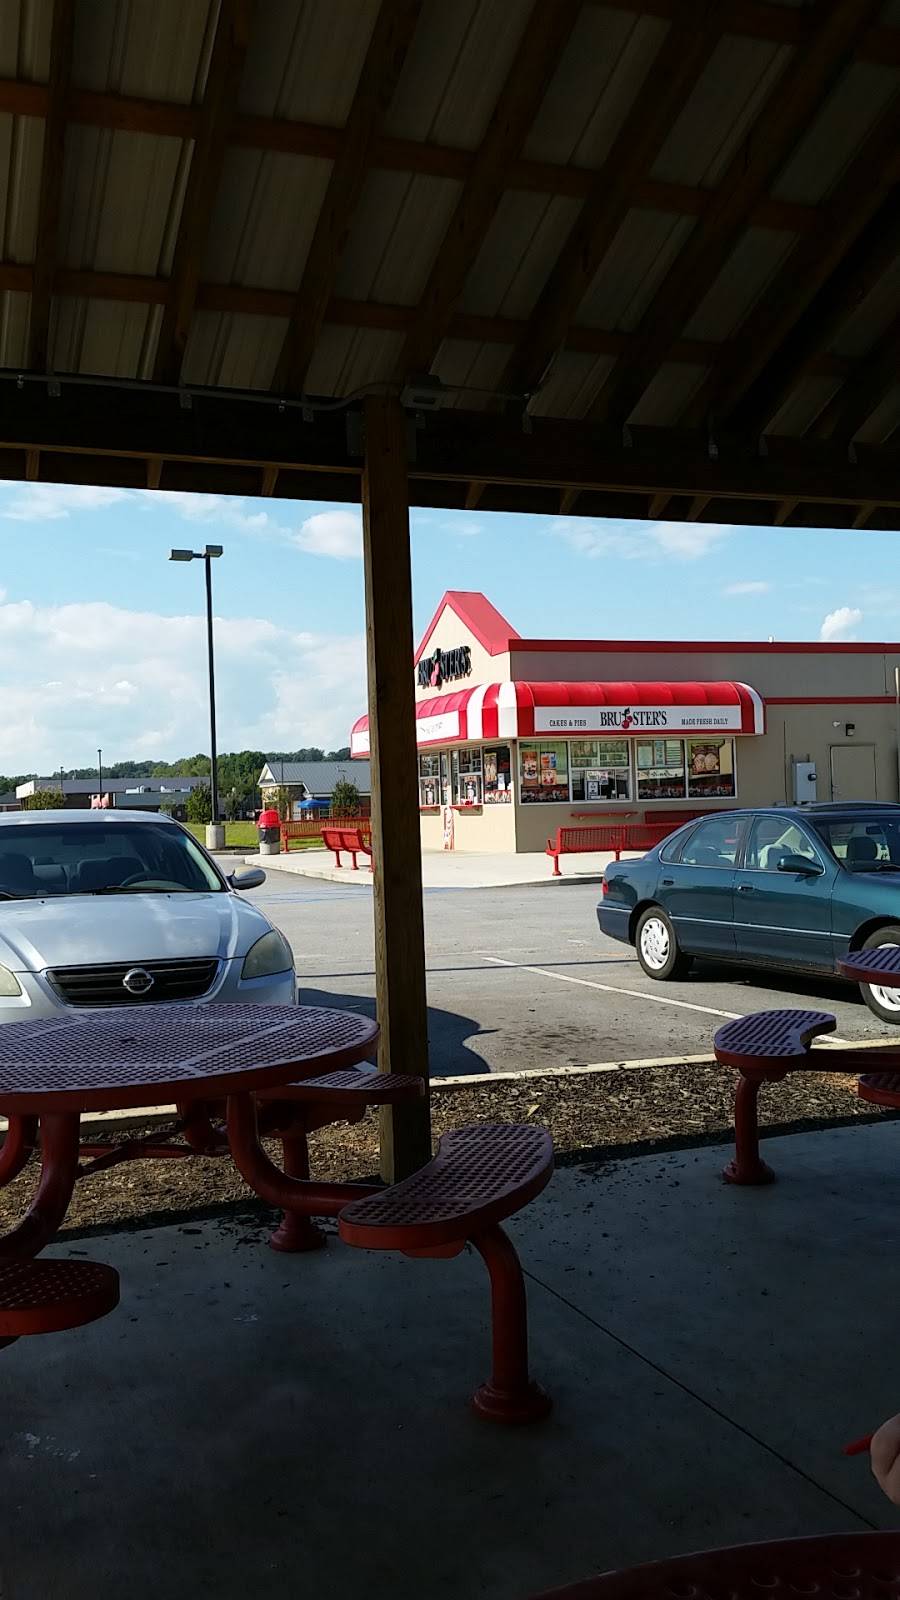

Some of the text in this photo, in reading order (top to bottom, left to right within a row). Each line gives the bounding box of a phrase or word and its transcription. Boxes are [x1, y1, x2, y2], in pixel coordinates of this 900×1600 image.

[549, 719, 568, 727] CAKES
[574, 719, 587, 727] PIES
[600, 709, 667, 728] BRUSTER'S
[681, 718, 696, 726] MADE
[713, 717, 729, 725] DAILY
